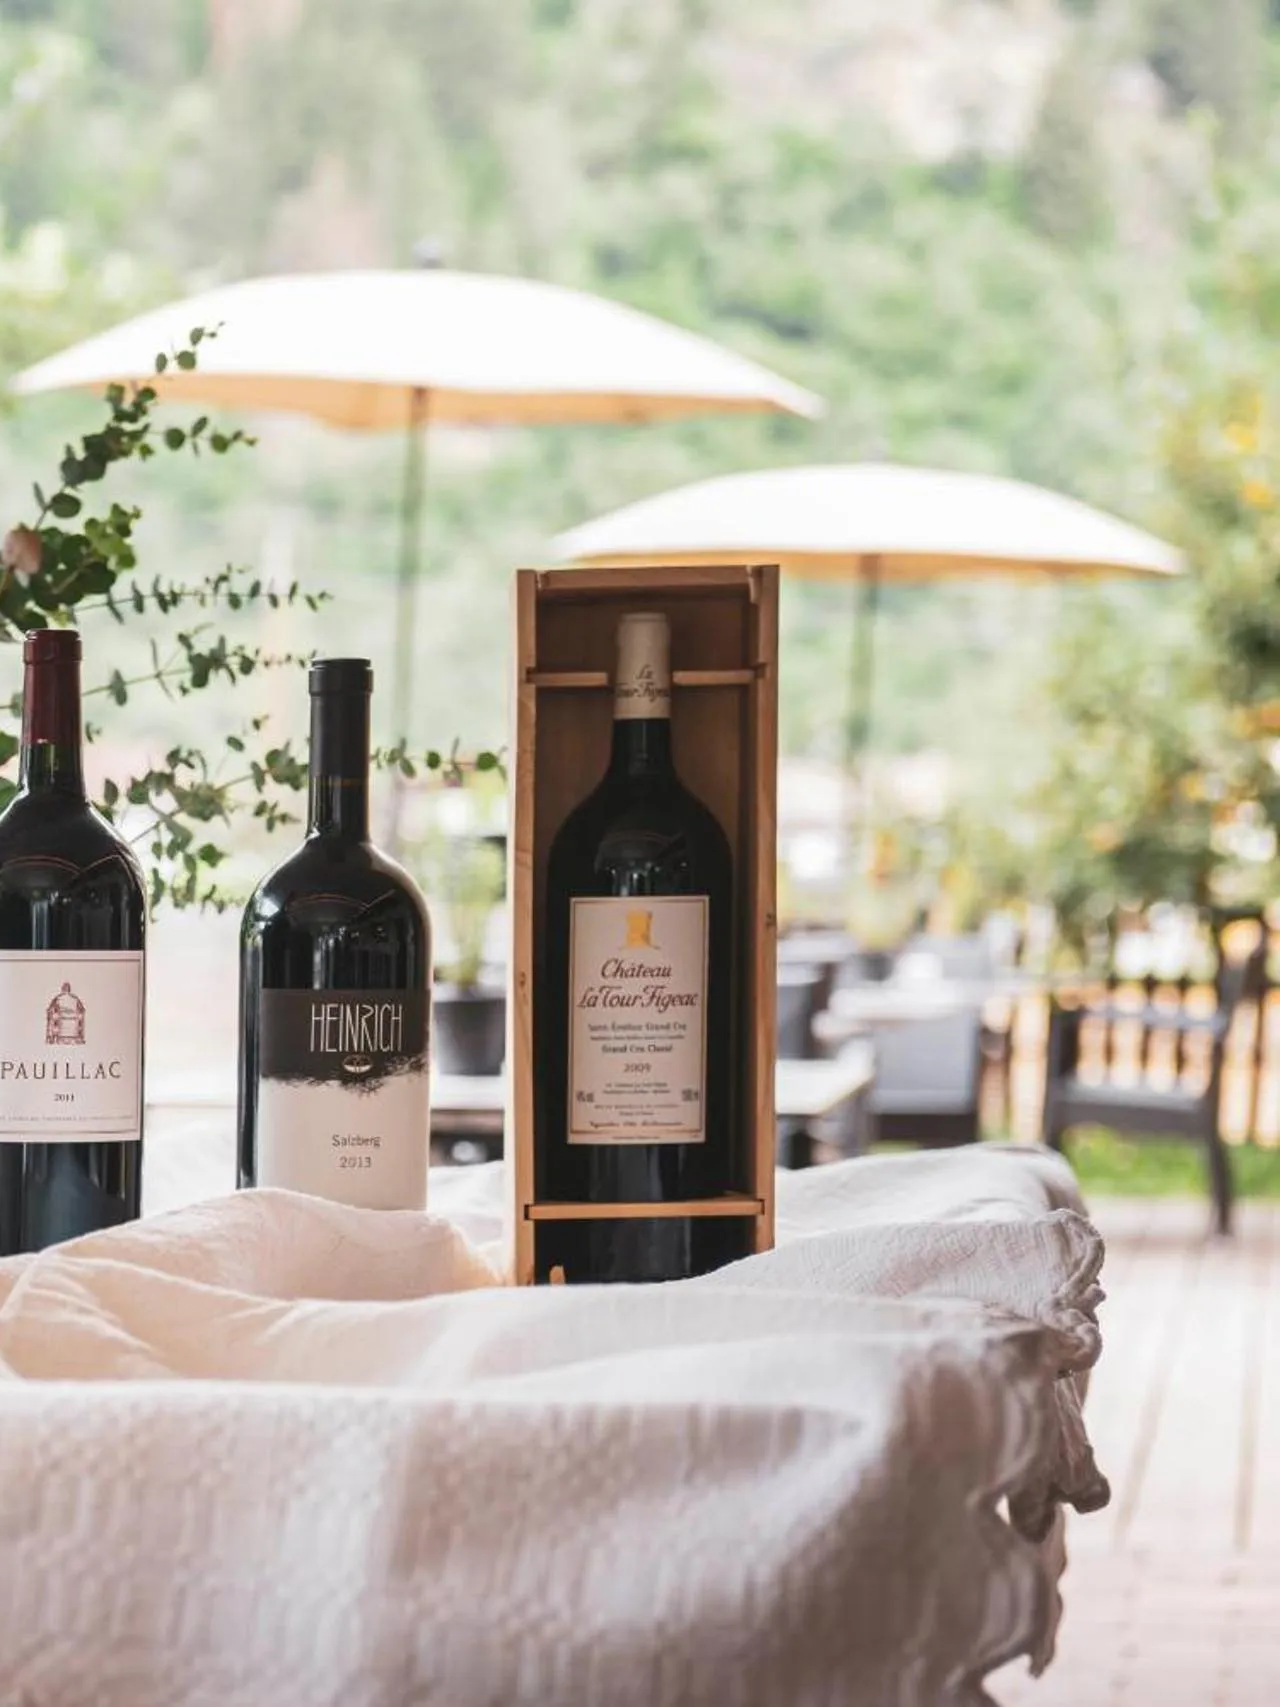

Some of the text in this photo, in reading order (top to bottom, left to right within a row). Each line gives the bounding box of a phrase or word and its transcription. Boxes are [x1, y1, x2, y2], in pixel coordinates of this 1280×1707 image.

[601, 958, 672, 979] Château
[641, 984, 699, 1014] Figeac
[310, 1003, 403, 1053] HEINRICH
[0, 1061, 122, 1080] PAUILLAC
[332, 1134, 382, 1149] Salzberg
[340, 1157, 372, 1169] 2013
